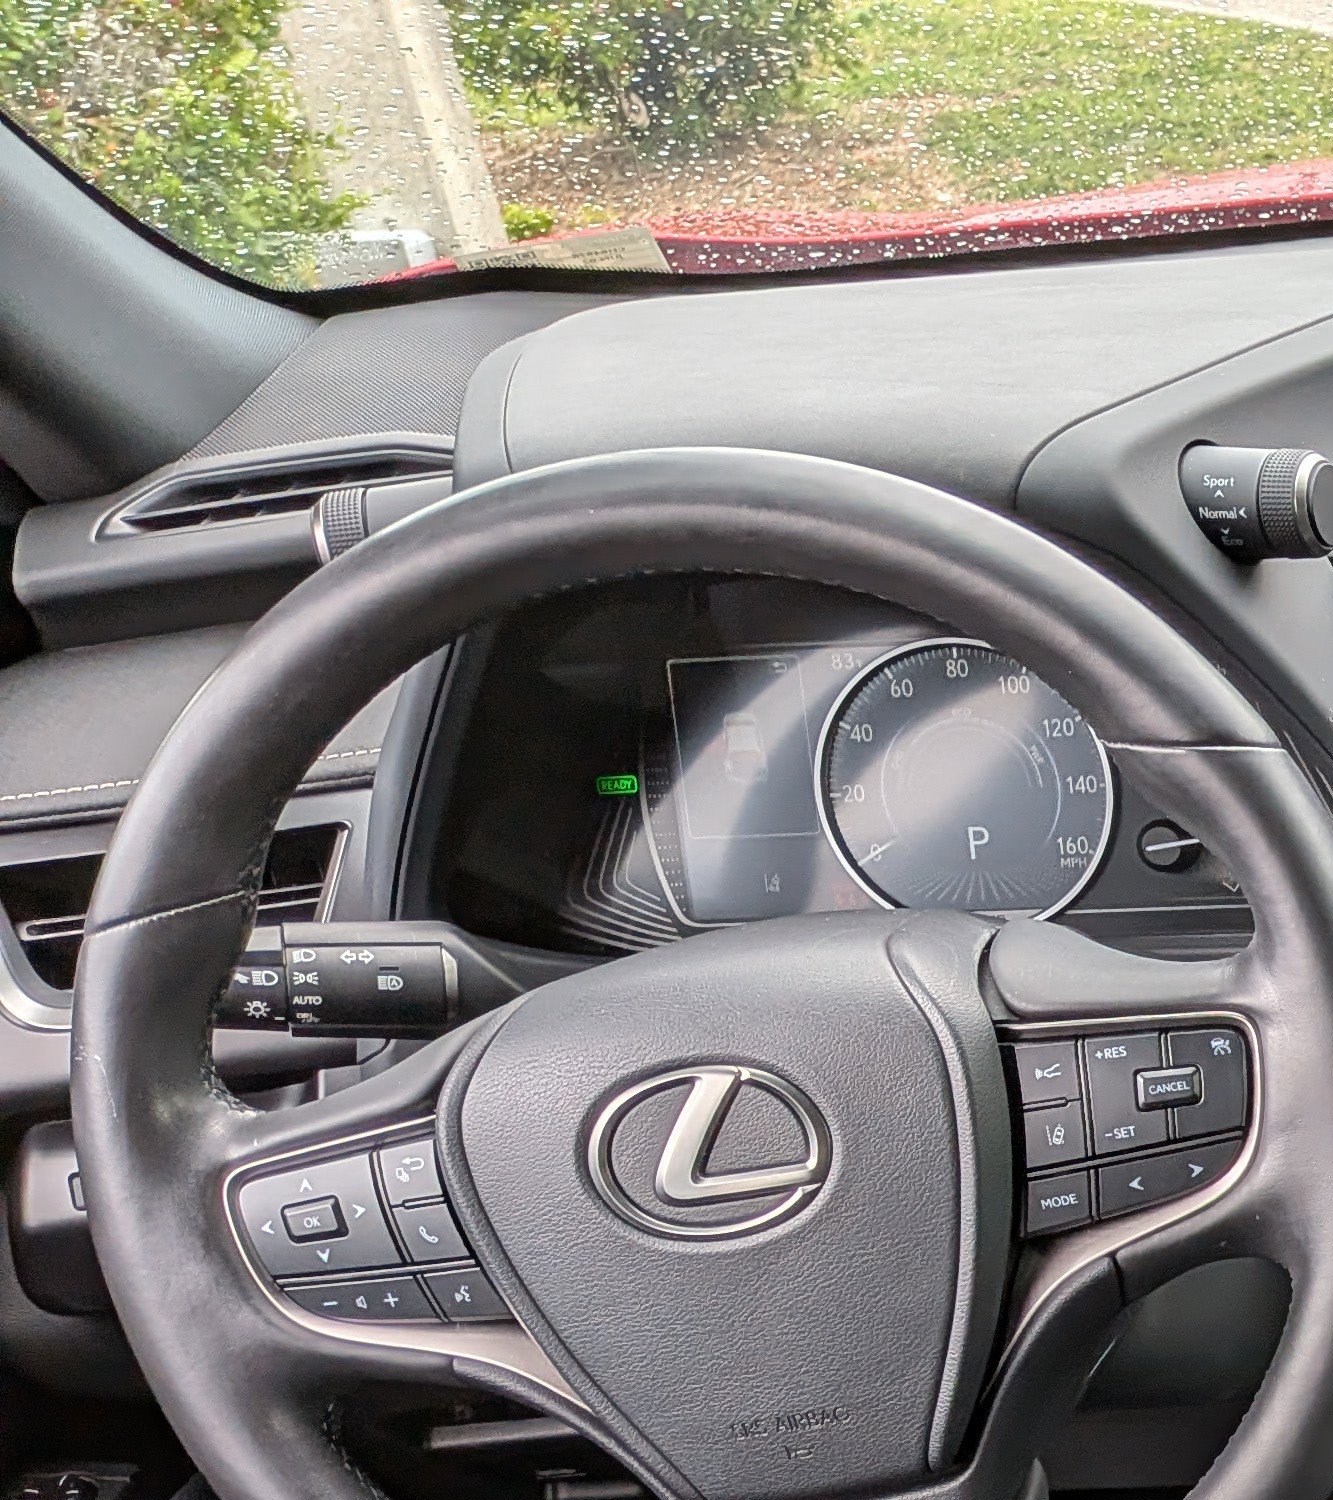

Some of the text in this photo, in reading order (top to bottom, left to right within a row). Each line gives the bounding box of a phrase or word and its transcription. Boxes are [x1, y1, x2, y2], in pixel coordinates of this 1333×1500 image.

[1203, 474, 1235, 489] Sport
[1198, 507, 1238, 519] Normal
[945, 658, 969, 678] 80
[890, 678, 913, 698] 60
[998, 676, 1030, 695] 100
[850, 723, 873, 743] 40
[1042, 717, 1074, 738] 120
[601, 779, 632, 791] READY
[842, 784, 865, 803] 20
[1065, 775, 1097, 794] 140
[967, 826, 989, 860] P
[1057, 836, 1088, 856] 160
[1060, 857, 1088, 869] MPH
[292, 995, 322, 1006] AUTO
[1148, 1080, 1191, 1096] CANCEL
[1040, 1193, 1078, 1210] MODE
[303, 1215, 322, 1229] OK
